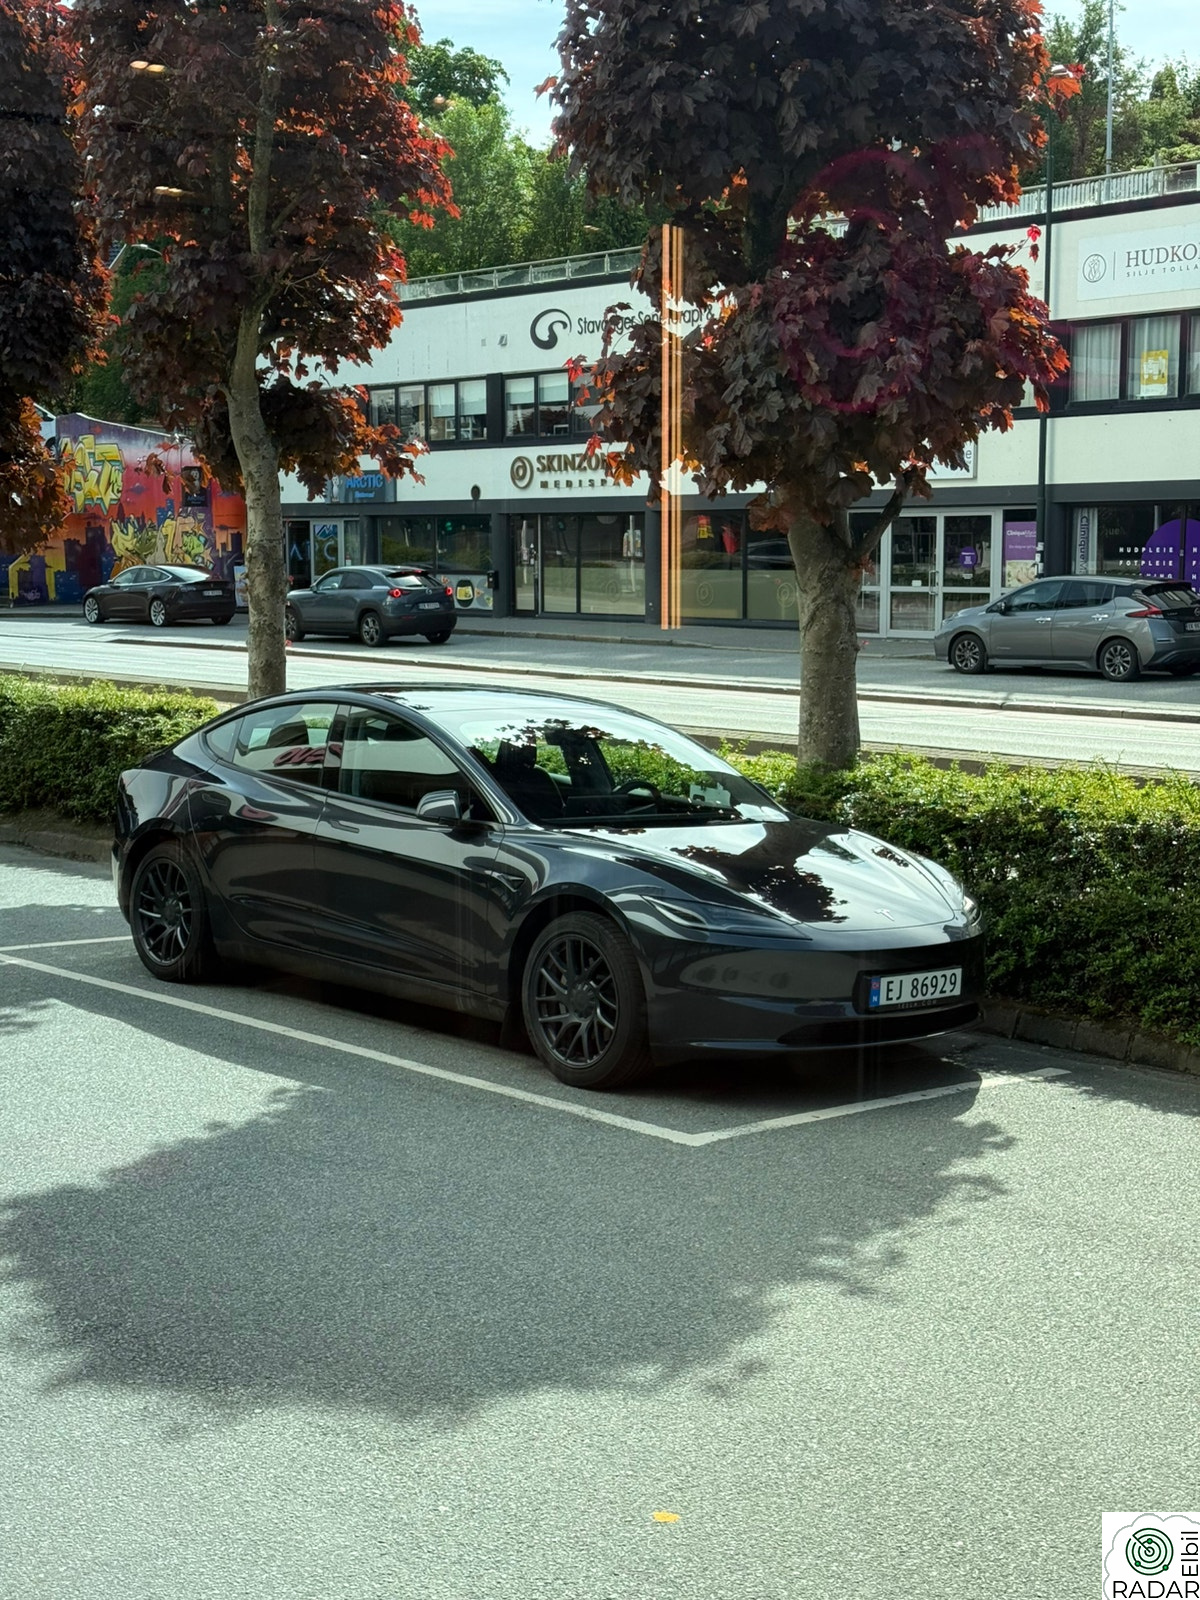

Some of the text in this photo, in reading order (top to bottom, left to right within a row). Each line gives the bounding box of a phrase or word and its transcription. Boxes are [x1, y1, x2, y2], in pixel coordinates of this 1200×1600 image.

[1125, 243, 1200, 268] HUDKO
[1126, 268, 1155, 278] SILJE
[536, 452, 624, 473] SKINZO
[346, 474, 383, 488] ARCTIC
[1078, 516, 1089, 574] CliniqueM
[885, 972, 957, 1001] EJ 86929
